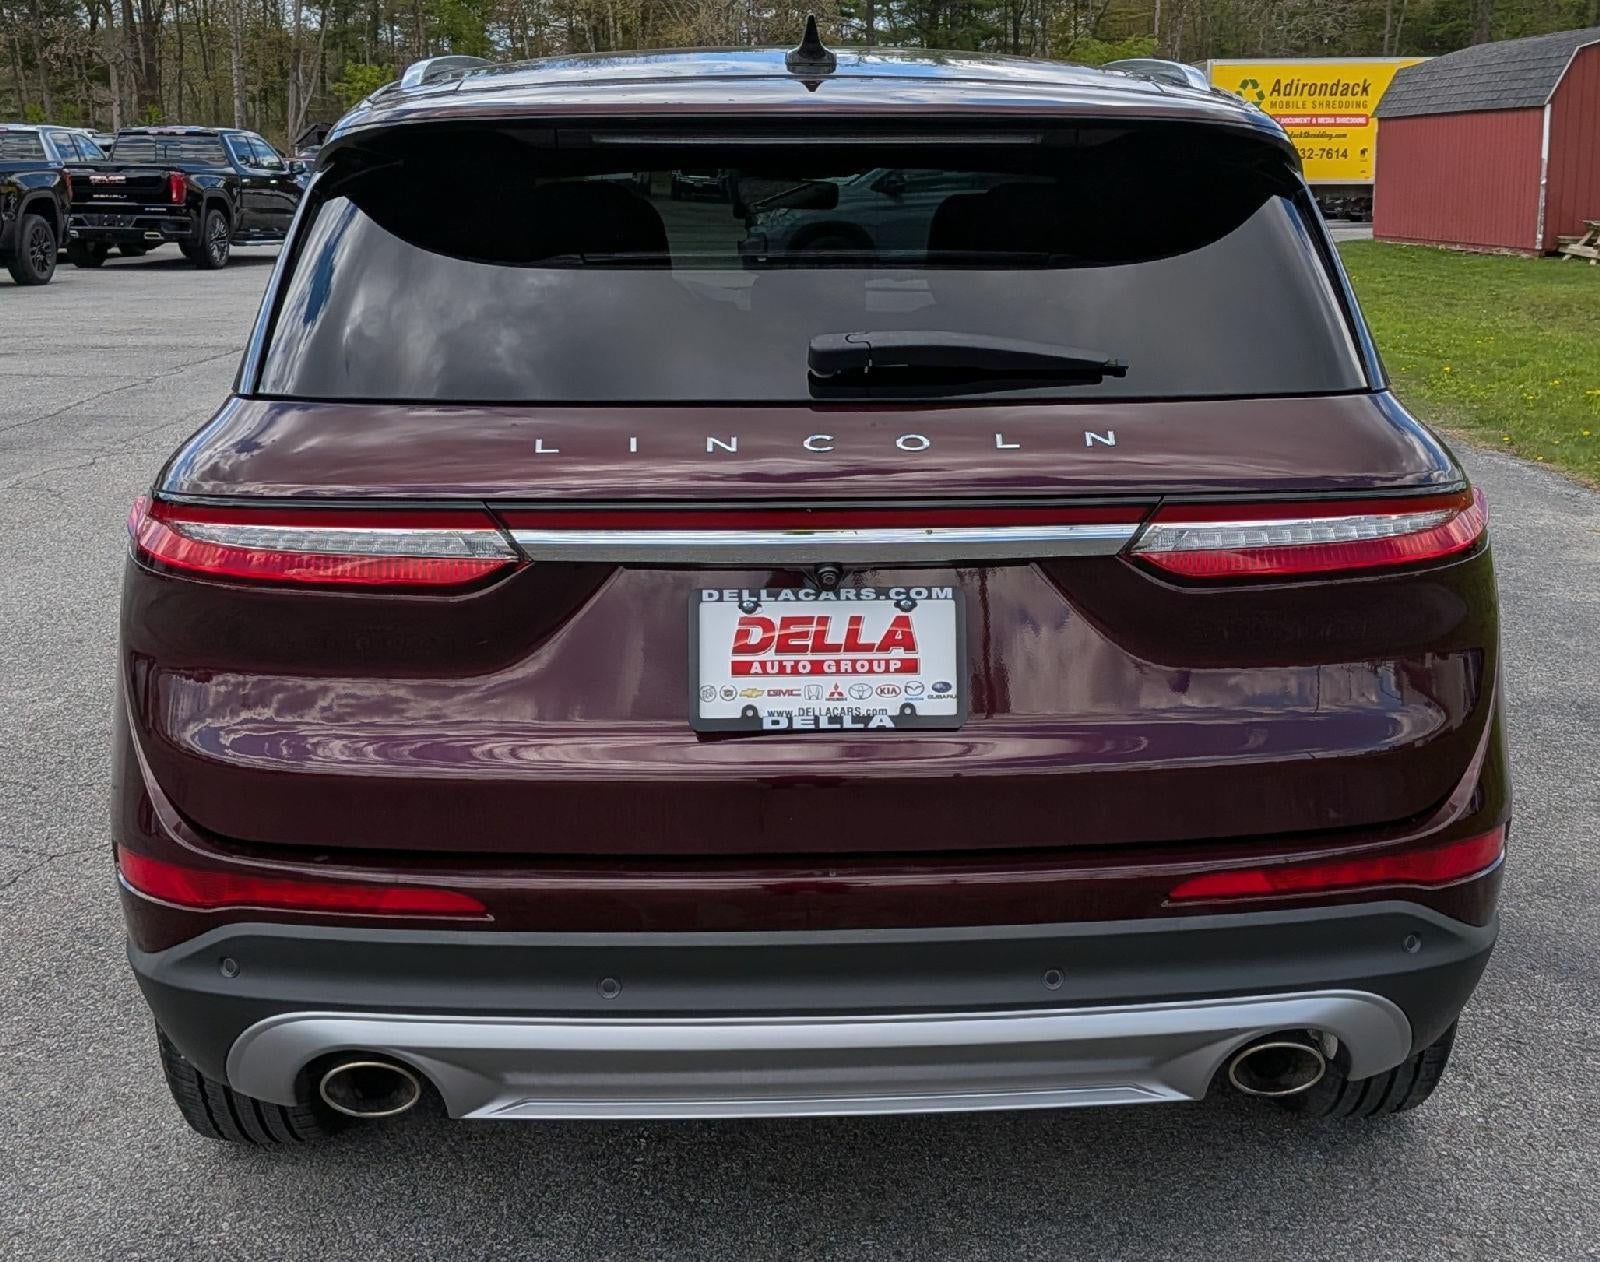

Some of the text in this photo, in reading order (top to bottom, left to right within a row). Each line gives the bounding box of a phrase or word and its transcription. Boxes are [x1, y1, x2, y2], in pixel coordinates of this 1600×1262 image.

[1269, 78, 1371, 97] Adirondack
[1269, 100, 1368, 109] MOBILE SHREDDING
[1297, 147, 1348, 160] 32-7614
[535, 430, 1116, 454] LINCOLN
[702, 588, 953, 601] DELLACARS.COM
[731, 615, 918, 655] DELLA
[750, 660, 902, 674] AUTO GROUP
[767, 689, 801, 697] GMC
[880, 687, 897, 695] KIA
[767, 706, 888, 718] www.DELLACARS.com
[763, 716, 895, 729] DELLA
